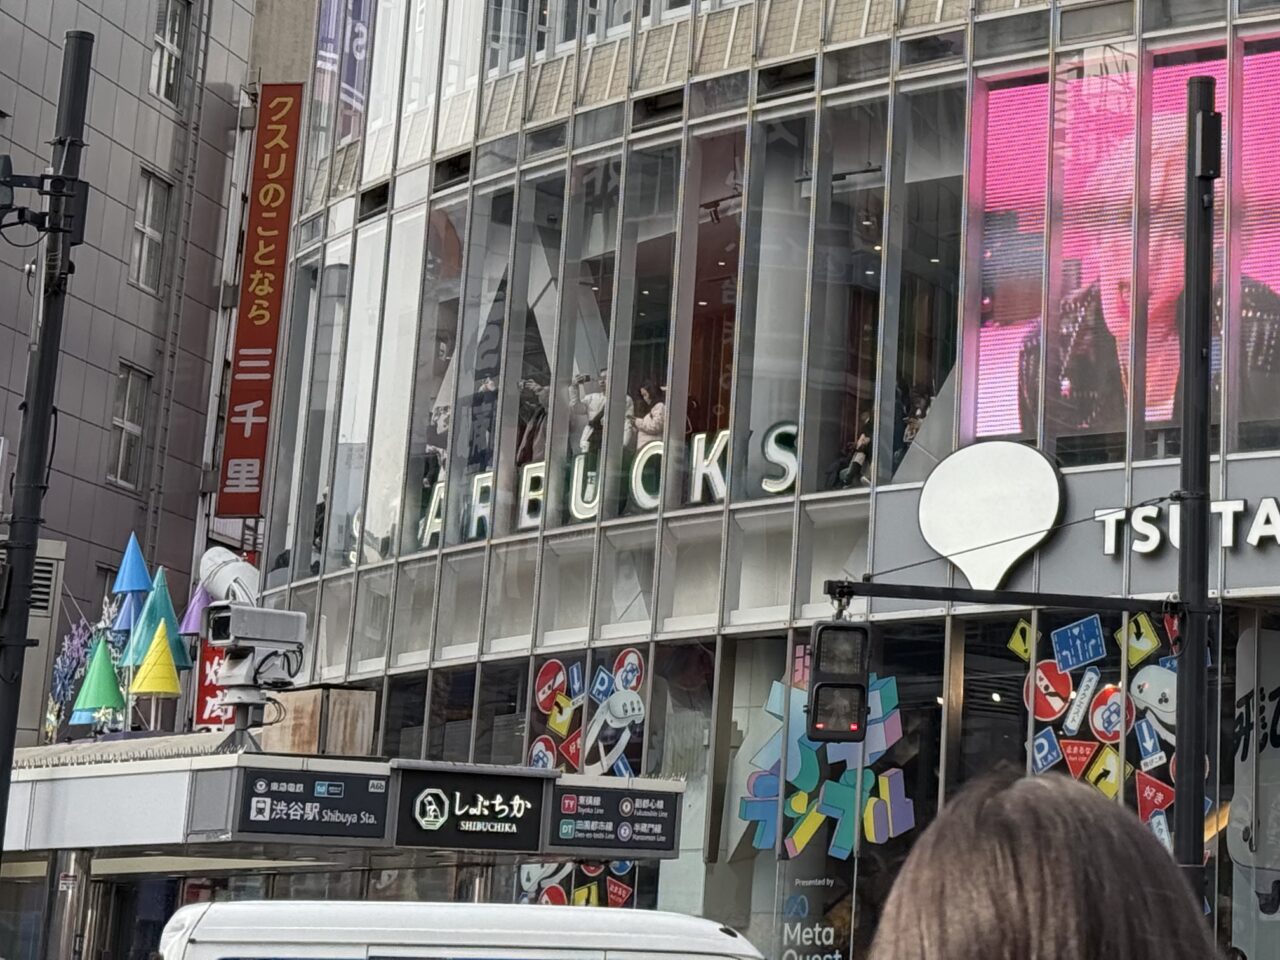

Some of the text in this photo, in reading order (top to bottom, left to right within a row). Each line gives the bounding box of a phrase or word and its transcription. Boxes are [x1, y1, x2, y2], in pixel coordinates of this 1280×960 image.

[223, 96, 295, 494] クスリのことなら 三千里
[270, 800, 377, 826] 渋谷駅 Shibuya Sta.
[454, 791, 532, 818] しぶちか
[460, 820, 518, 833] SHIBUCHIKA
[795, 878, 835, 888] Presented by
[783, 921, 835, 946] Meta
